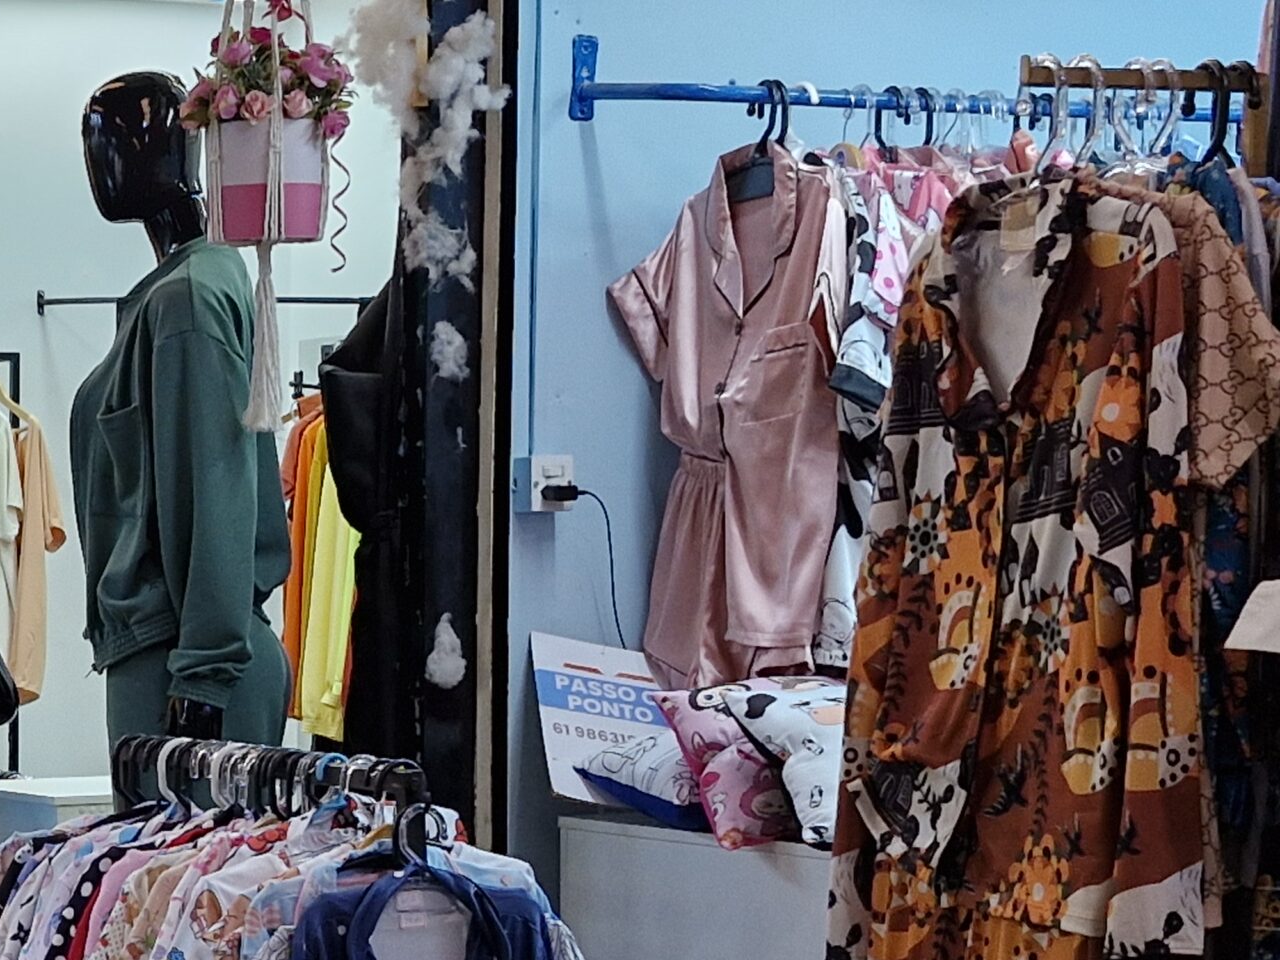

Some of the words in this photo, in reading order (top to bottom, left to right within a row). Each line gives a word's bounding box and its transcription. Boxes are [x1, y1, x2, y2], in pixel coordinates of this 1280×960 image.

[554, 673, 636, 703] PASSO
[567, 694, 654, 723] PONTO
[553, 722, 570, 736] 61
